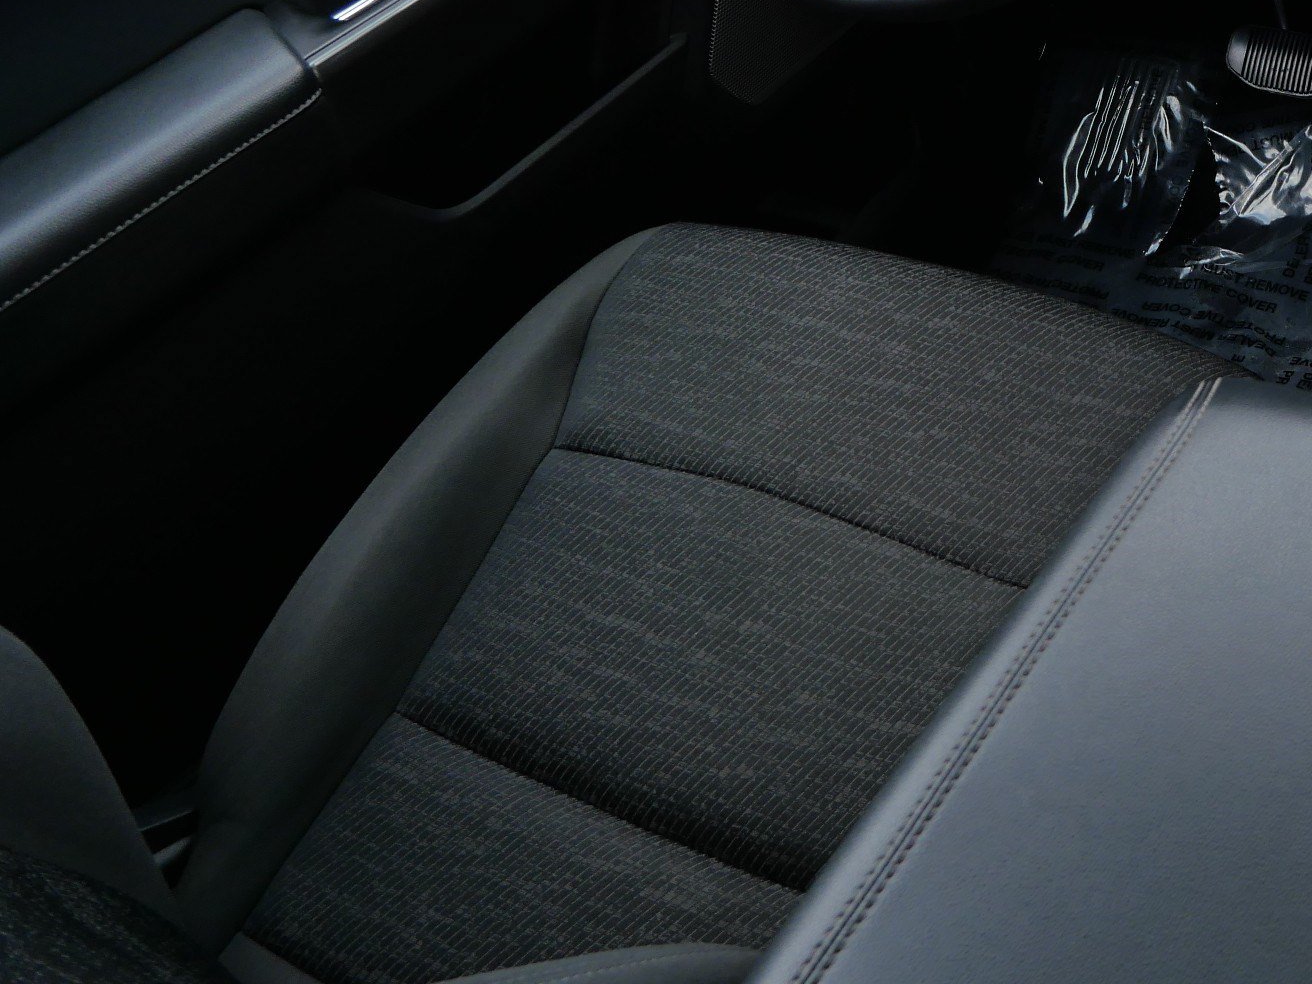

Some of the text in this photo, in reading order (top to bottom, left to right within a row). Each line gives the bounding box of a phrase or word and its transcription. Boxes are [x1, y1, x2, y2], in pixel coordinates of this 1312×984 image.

[1226, 287, 1278, 314] COVER
[1245, 276, 1311, 303] REMOVE
[1142, 302, 1192, 318] COVER
